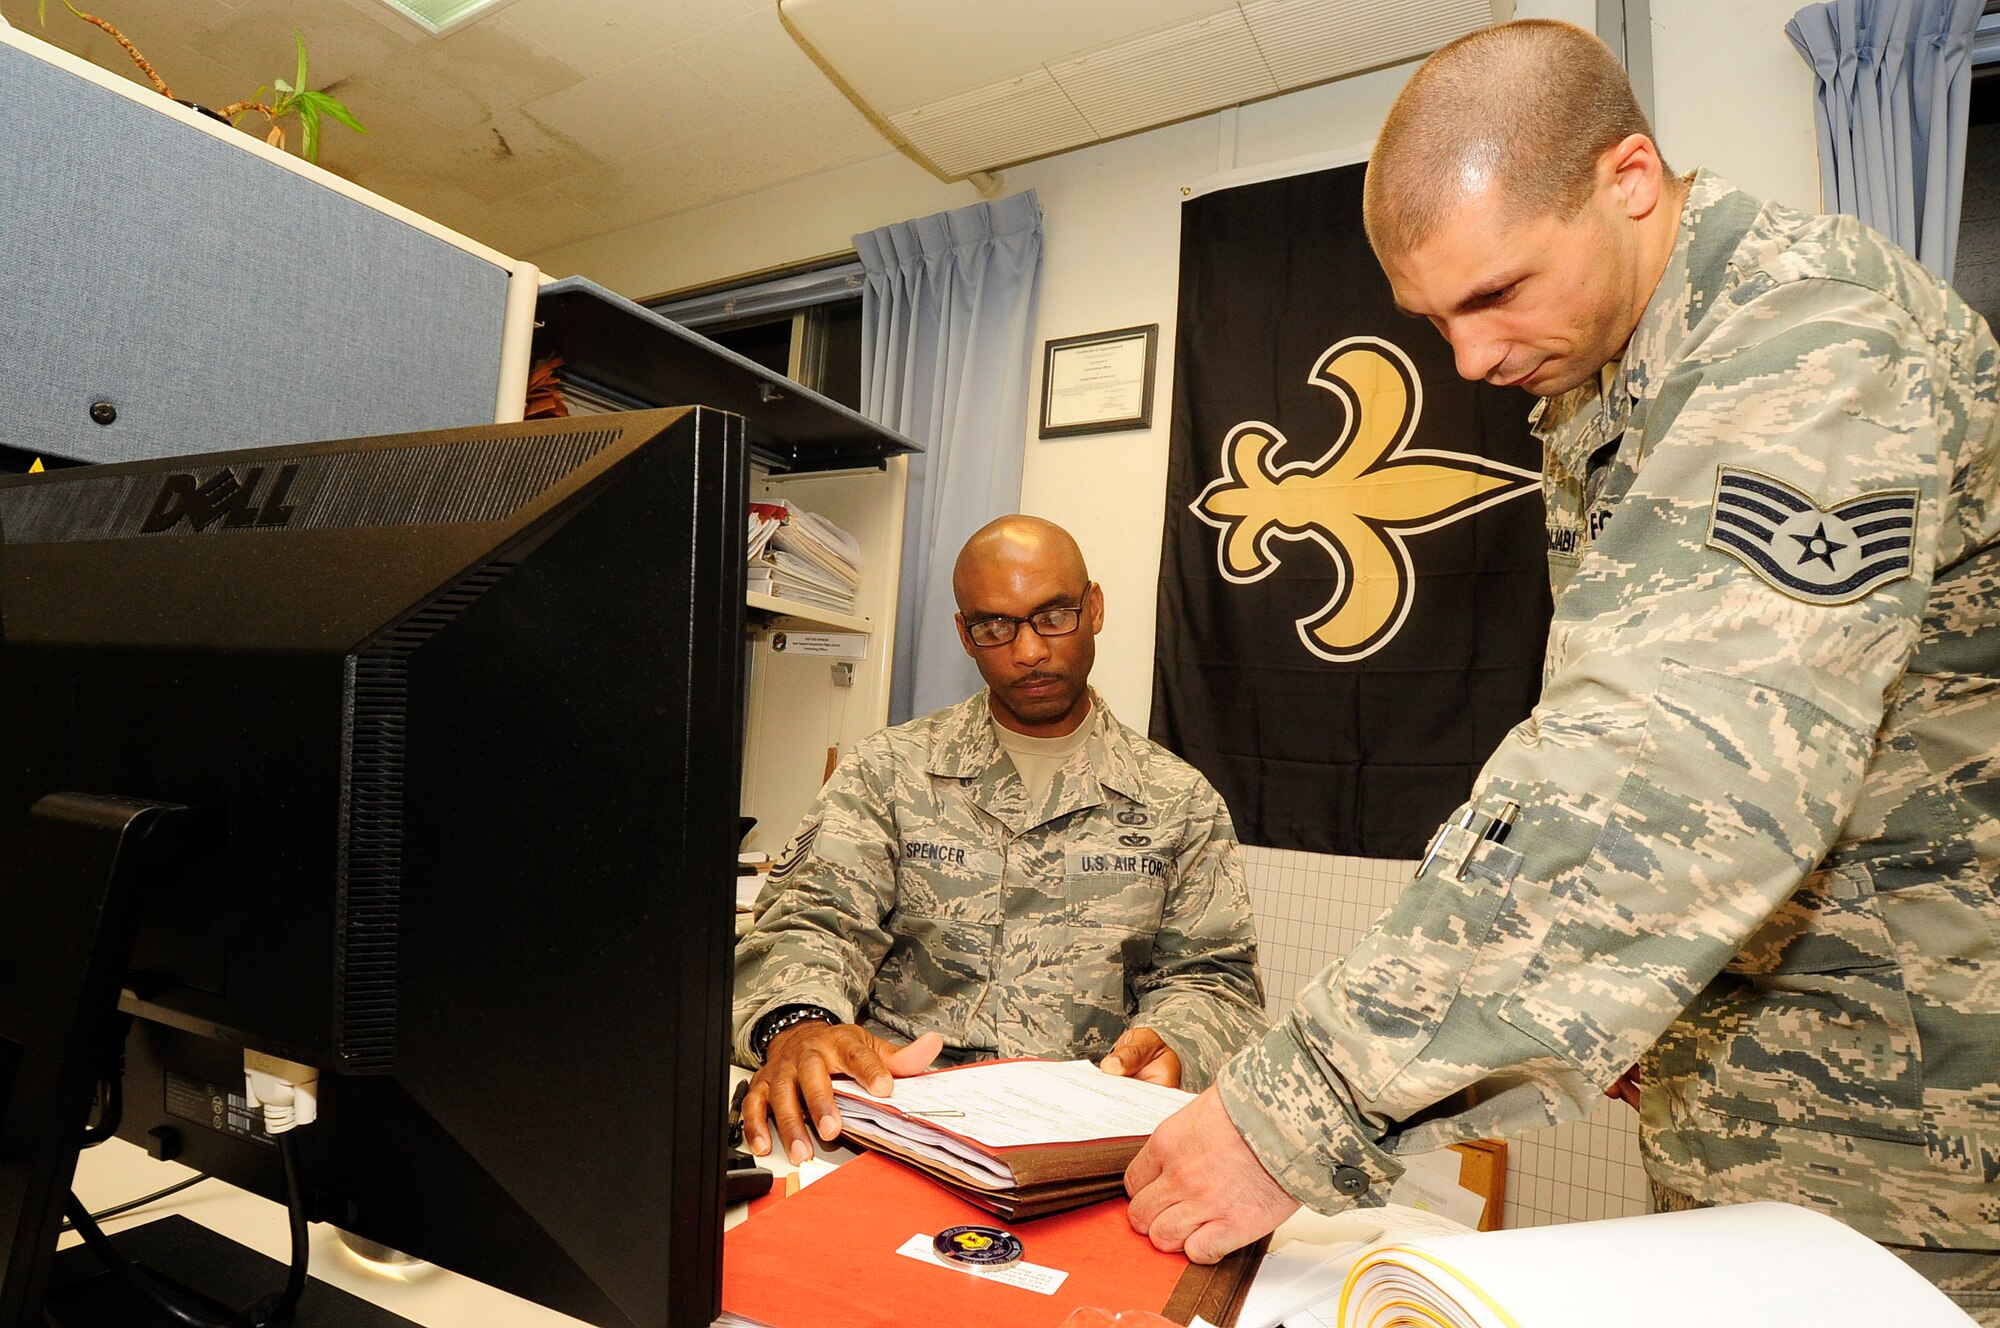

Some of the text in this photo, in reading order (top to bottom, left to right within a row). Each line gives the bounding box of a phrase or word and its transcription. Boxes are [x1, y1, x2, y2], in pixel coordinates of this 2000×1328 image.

[140, 464, 300, 533] DELL
[906, 842, 965, 864] SPENCER
[1081, 856, 1109, 872] U.S.
[1113, 856, 1137, 872] AIR
